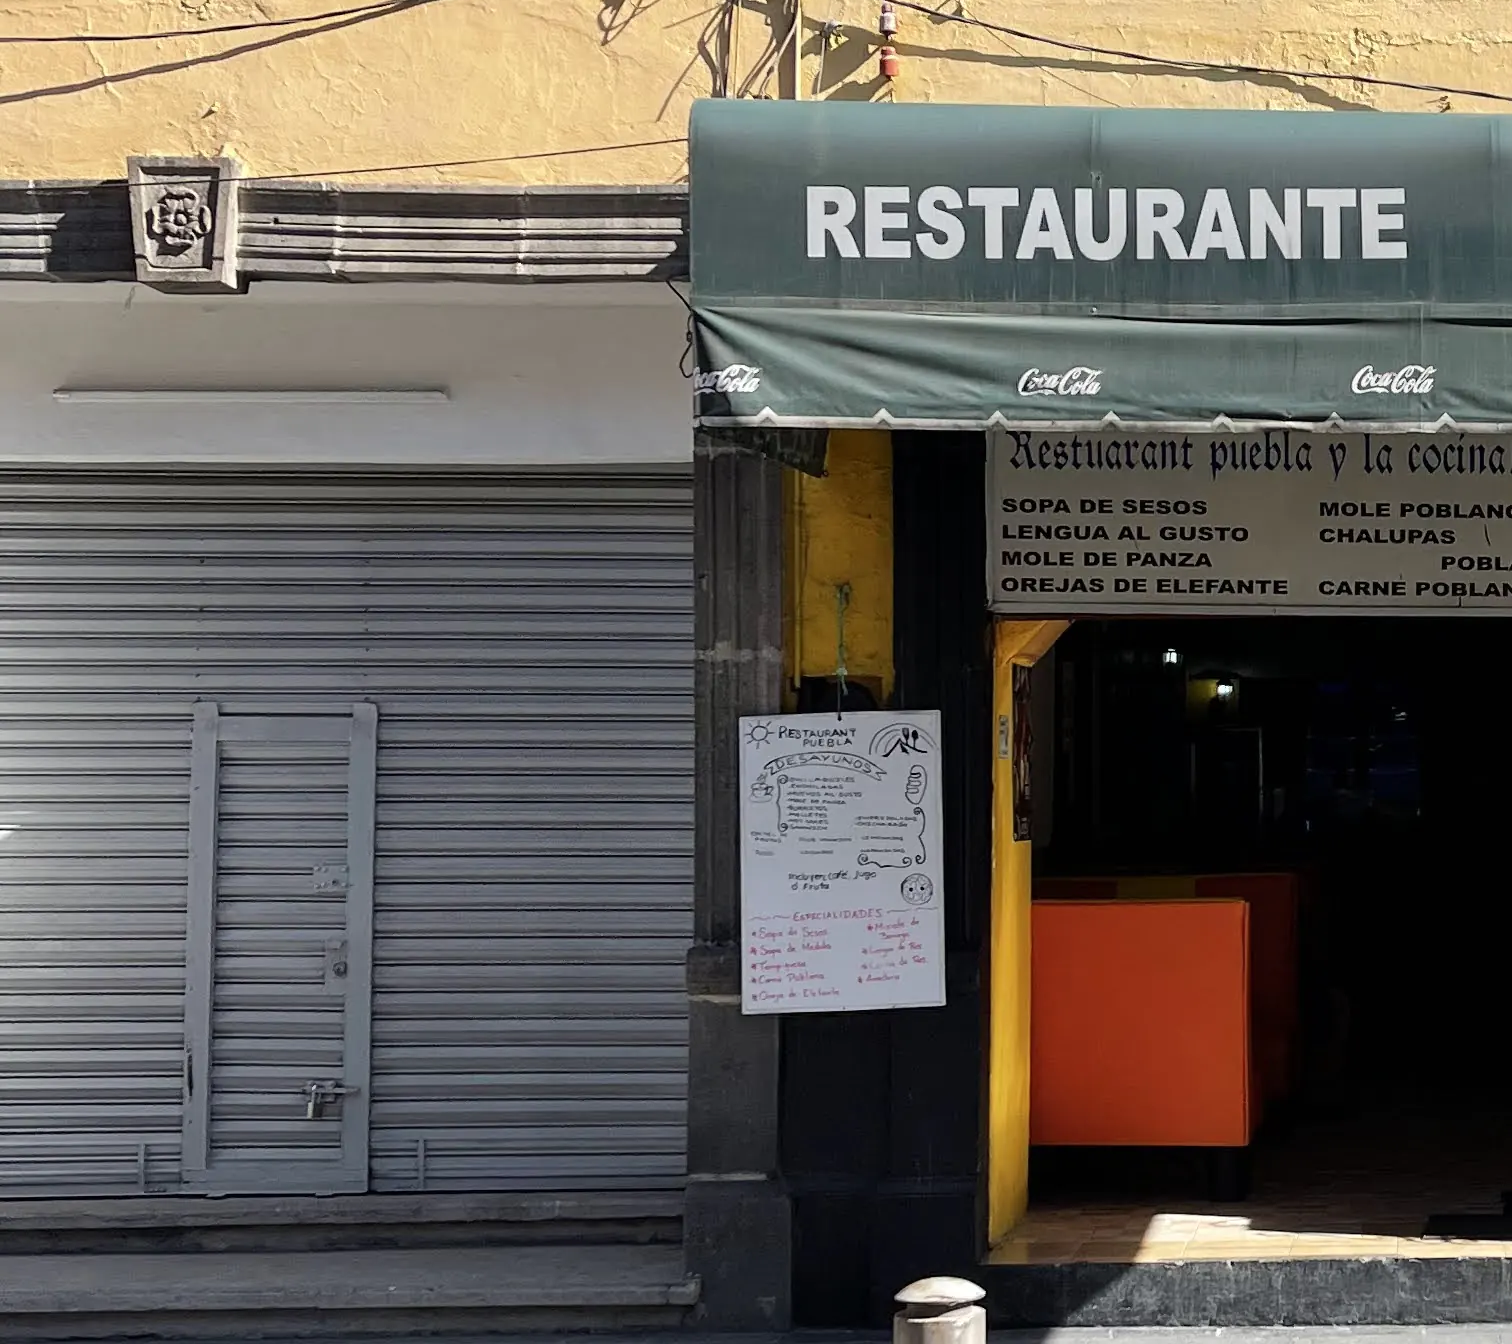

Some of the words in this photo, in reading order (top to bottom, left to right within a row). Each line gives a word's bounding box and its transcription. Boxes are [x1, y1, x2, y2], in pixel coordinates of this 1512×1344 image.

[806, 185, 1408, 261] RESTAURANTE
[1210, 431, 1312, 482] puebla
[1328, 441, 1347, 482] y
[1363, 433, 1393, 474] la
[1001, 498, 1071, 514] SOPA
[1080, 499, 1113, 515] DE
[1122, 499, 1208, 515] SESOS
[1319, 502, 1391, 517] MOLE
[1002, 524, 1110, 540] LENGUA
[1118, 526, 1151, 541] AL
[1159, 526, 1249, 542] GUSTO
[1319, 528, 1456, 544] CHALUPAS
[1001, 551, 1074, 566] MOLE
[1083, 552, 1117, 567] DE
[1126, 552, 1213, 567] PANZA
[1001, 577, 1105, 593] OREJAS
[1114, 578, 1147, 593] DE
[1156, 579, 1288, 595] ELEFANTE
[1318, 581, 1406, 596] CARNE
[778, 725, 857, 739] RESTAURANT
[803, 738, 853, 747] PUEBLA
[774, 754, 872, 774] DESAYUNOS
[792, 908, 883, 922] ESPECIALIDADES
